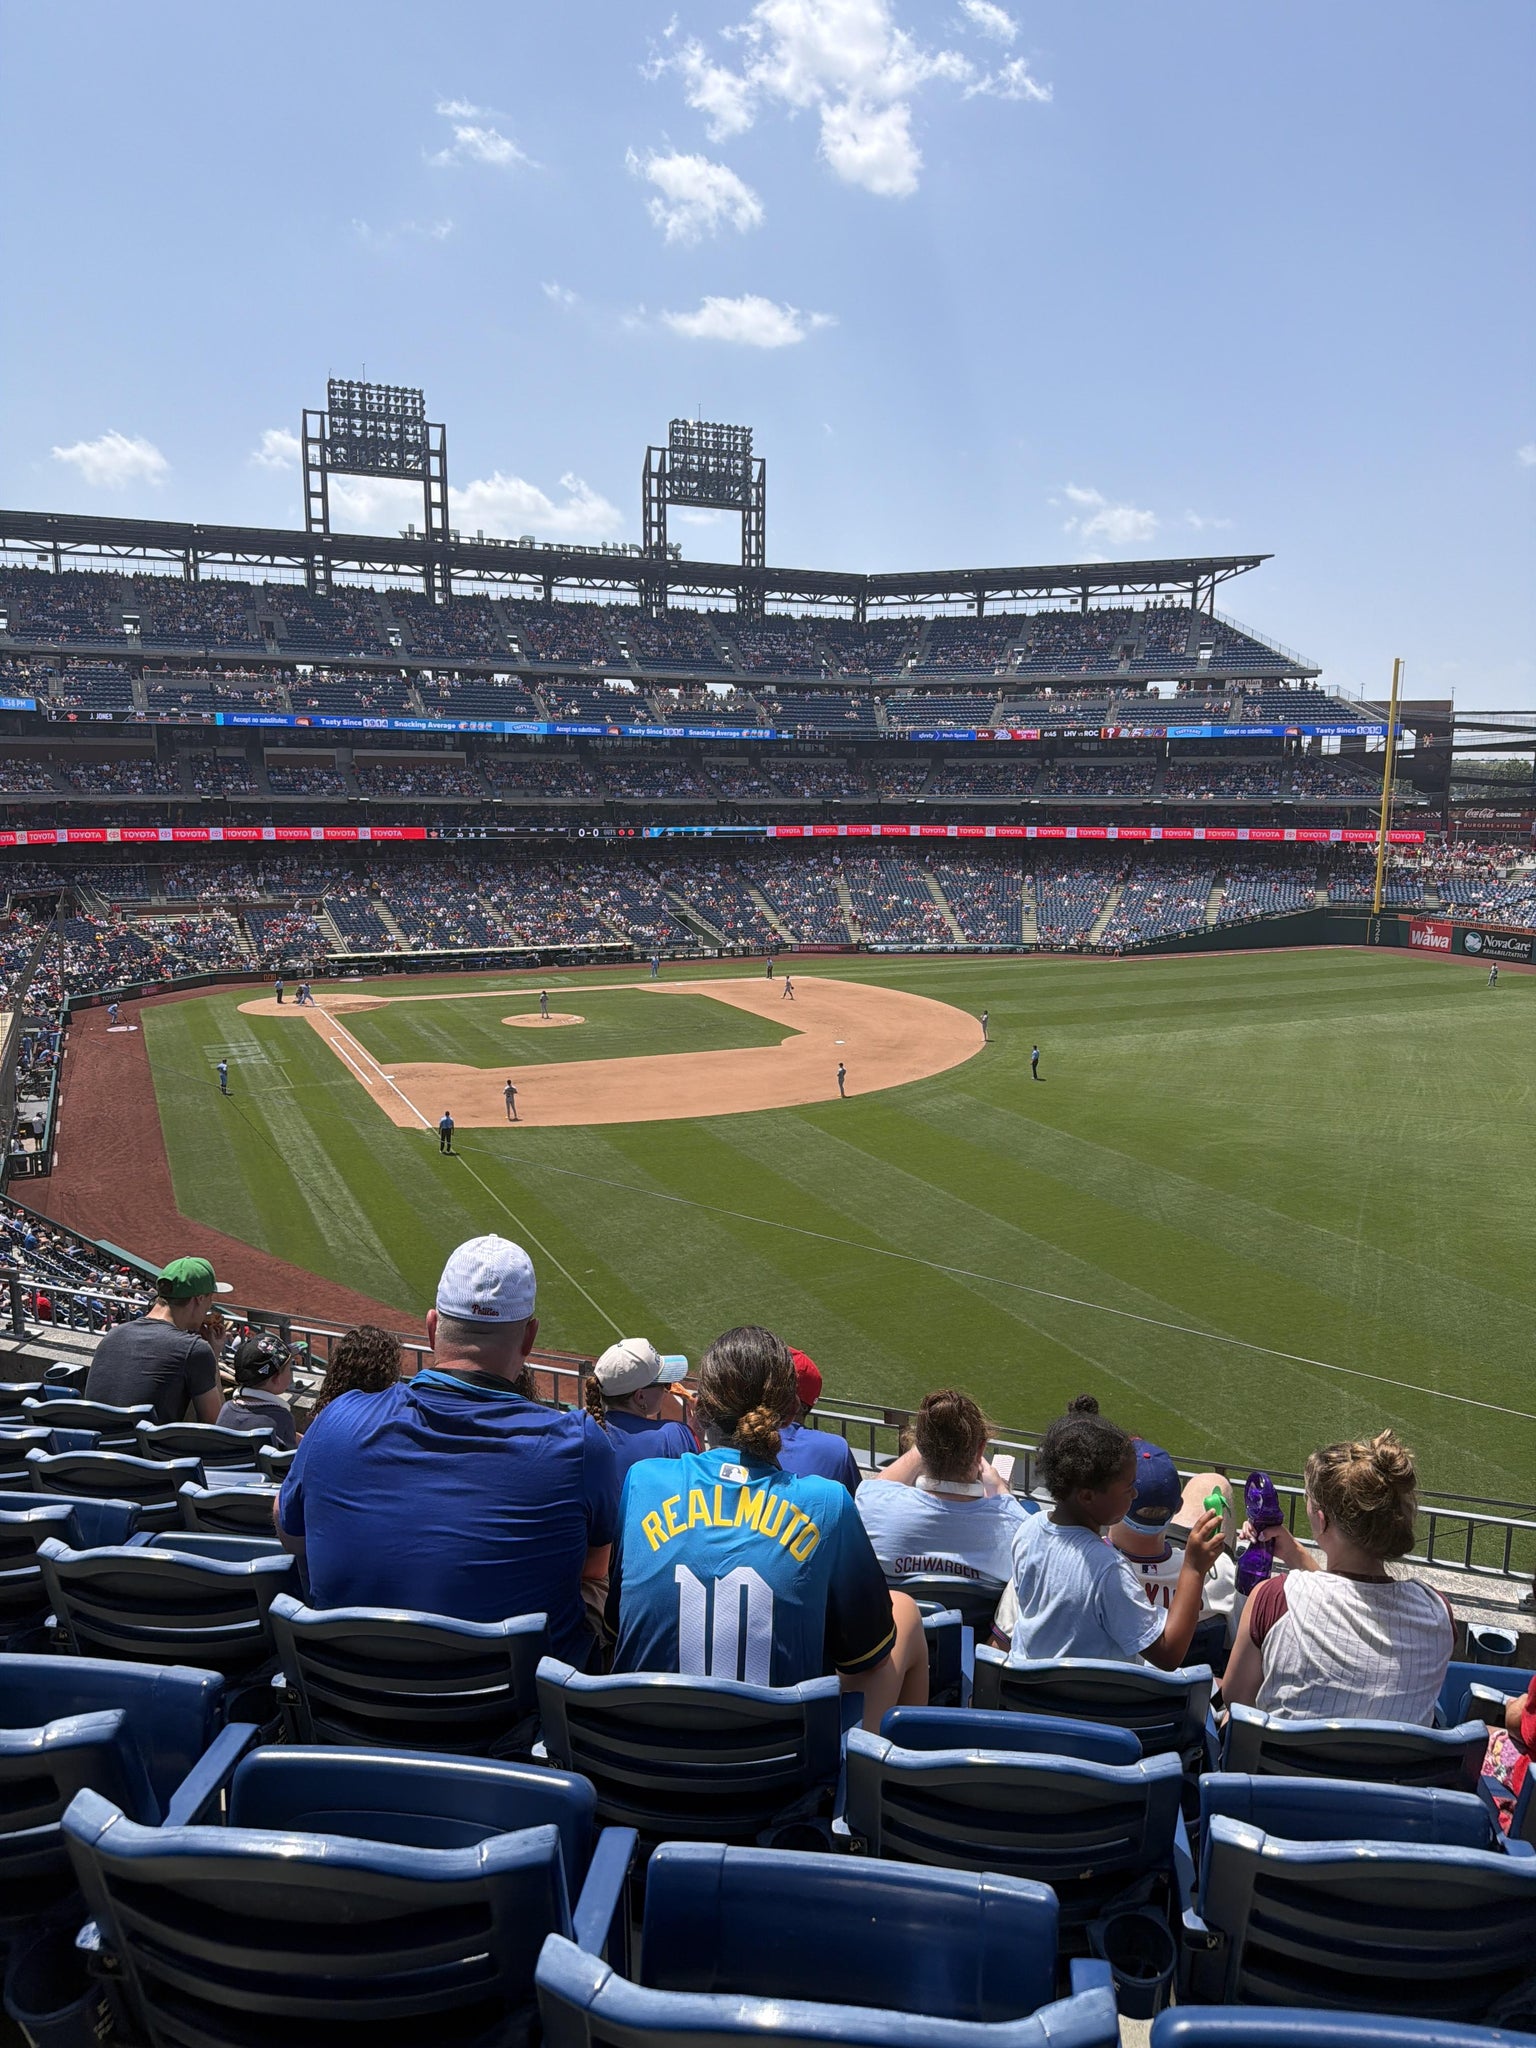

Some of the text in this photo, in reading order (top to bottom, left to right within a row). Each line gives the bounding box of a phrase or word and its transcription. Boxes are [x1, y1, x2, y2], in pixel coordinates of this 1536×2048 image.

[233, 716, 251, 724] Accept
[321, 718, 341, 726] Tasty
[363, 719, 389, 727] 1914
[394, 721, 456, 730] Snacking Average
[629, 728, 647, 736] Tasty
[663, 728, 684, 736] 1914
[716, 730, 740, 738] Average
[1315, 727, 1335, 735] Tasty
[1356, 726, 1382, 735] 1914
[29, 832, 56, 841] TOYOTA
[69, 831, 101, 839] TOYOTA
[1344, 832, 1374, 840] TOYOTA
[1413, 916, 1445, 925] ASPLUNDH
[1451, 920, 1484, 929] ASPLUNDH
[1490, 925, 1526, 934] ASPLUNDH
[1411, 929, 1449, 948] Wawa
[1482, 935, 1531, 952] NovaCare
[1482, 948, 1528, 959] REHABILITATION
[102, 993, 122, 1001] TOYOTA
[641, 1484, 821, 1562] REALMUTO
[675, 1564, 774, 1688] 10
